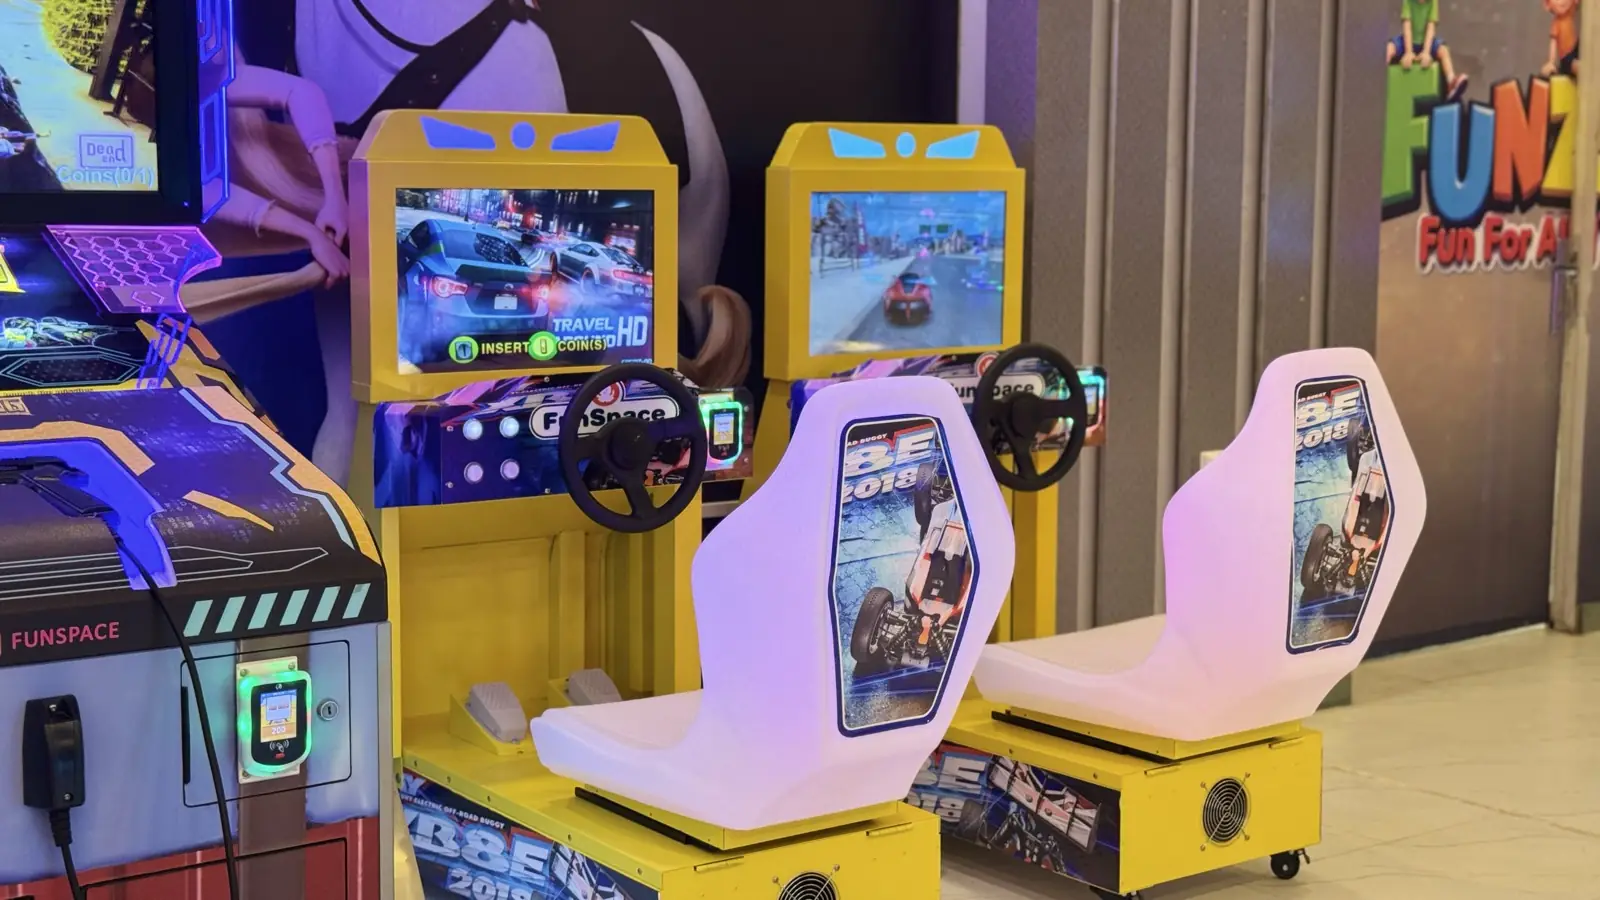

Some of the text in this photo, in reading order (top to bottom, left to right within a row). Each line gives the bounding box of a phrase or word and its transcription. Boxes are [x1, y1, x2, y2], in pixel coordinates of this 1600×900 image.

[56, 166, 154, 190] Coins(0/1)
[1419, 216, 1475, 265] Fun
[1483, 214, 1533, 263] For
[553, 317, 614, 332] TRAVEL
[616, 315, 649, 348] HD
[481, 342, 529, 355] INSERT
[557, 339, 608, 353] COIN(S)
[543, 408, 666, 430] FnSpace
[11, 621, 120, 650] FUNSPACE
